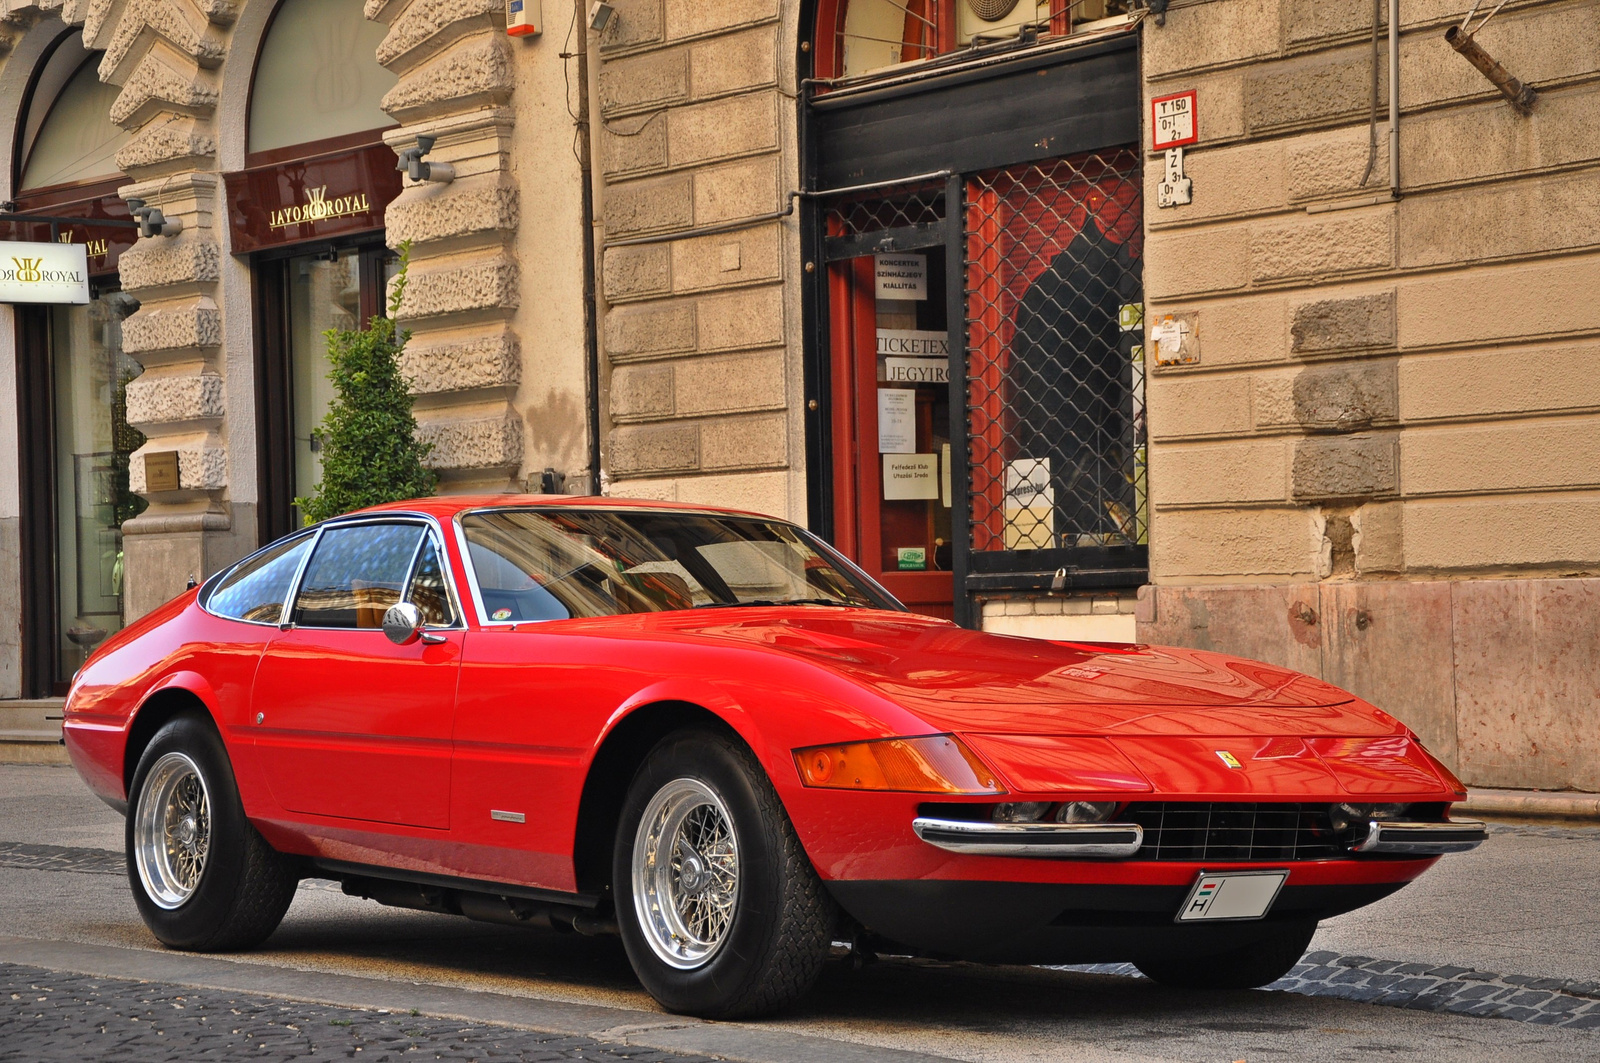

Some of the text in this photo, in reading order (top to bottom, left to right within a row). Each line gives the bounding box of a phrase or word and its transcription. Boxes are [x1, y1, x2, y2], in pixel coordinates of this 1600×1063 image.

[1161, 99, 1187, 114] T 150
[1171, 155, 1177, 168] Z
[326, 194, 370, 216] ROYAL
[879, 259, 920, 267] KONCERTEK
[42, 270, 84, 282] ROYAL
[891, 366, 949, 382] JEGYIR
[1190, 899, 1208, 912] H
